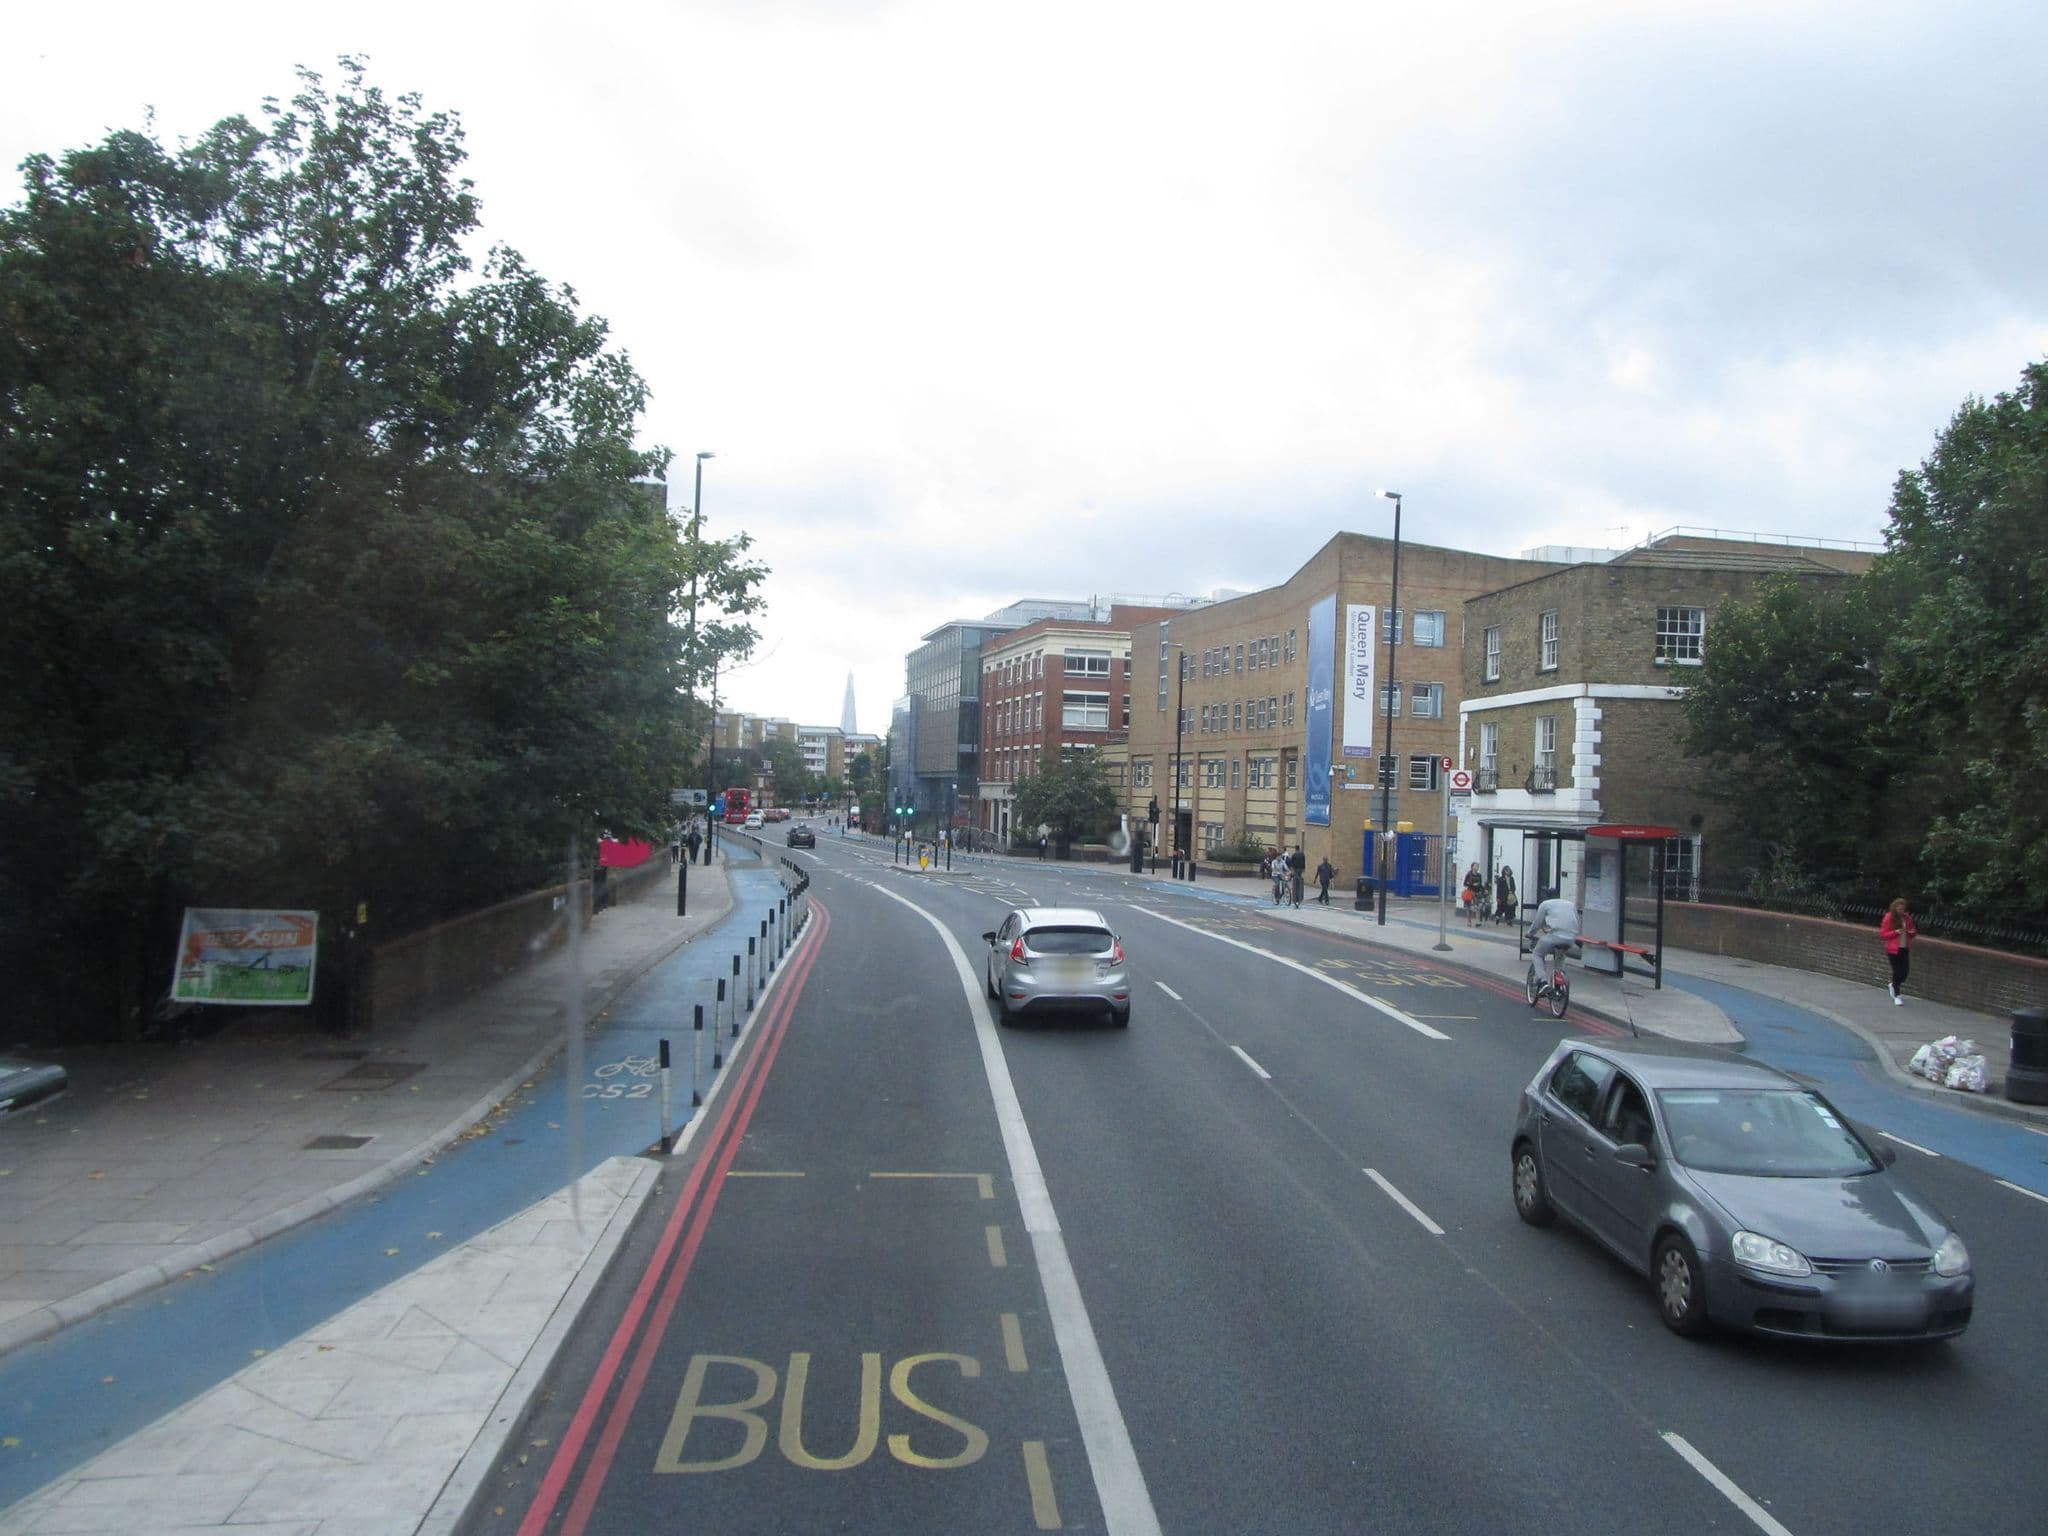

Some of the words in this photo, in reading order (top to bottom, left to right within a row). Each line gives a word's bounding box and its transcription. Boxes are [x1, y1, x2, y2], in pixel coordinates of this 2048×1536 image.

[1357, 611, 1370, 658] Queen
[1353, 664, 1368, 700] Mary
[1443, 758, 1450, 768] E
[582, 1083, 653, 1098] CS2
[653, 1352, 989, 1474] BUS
